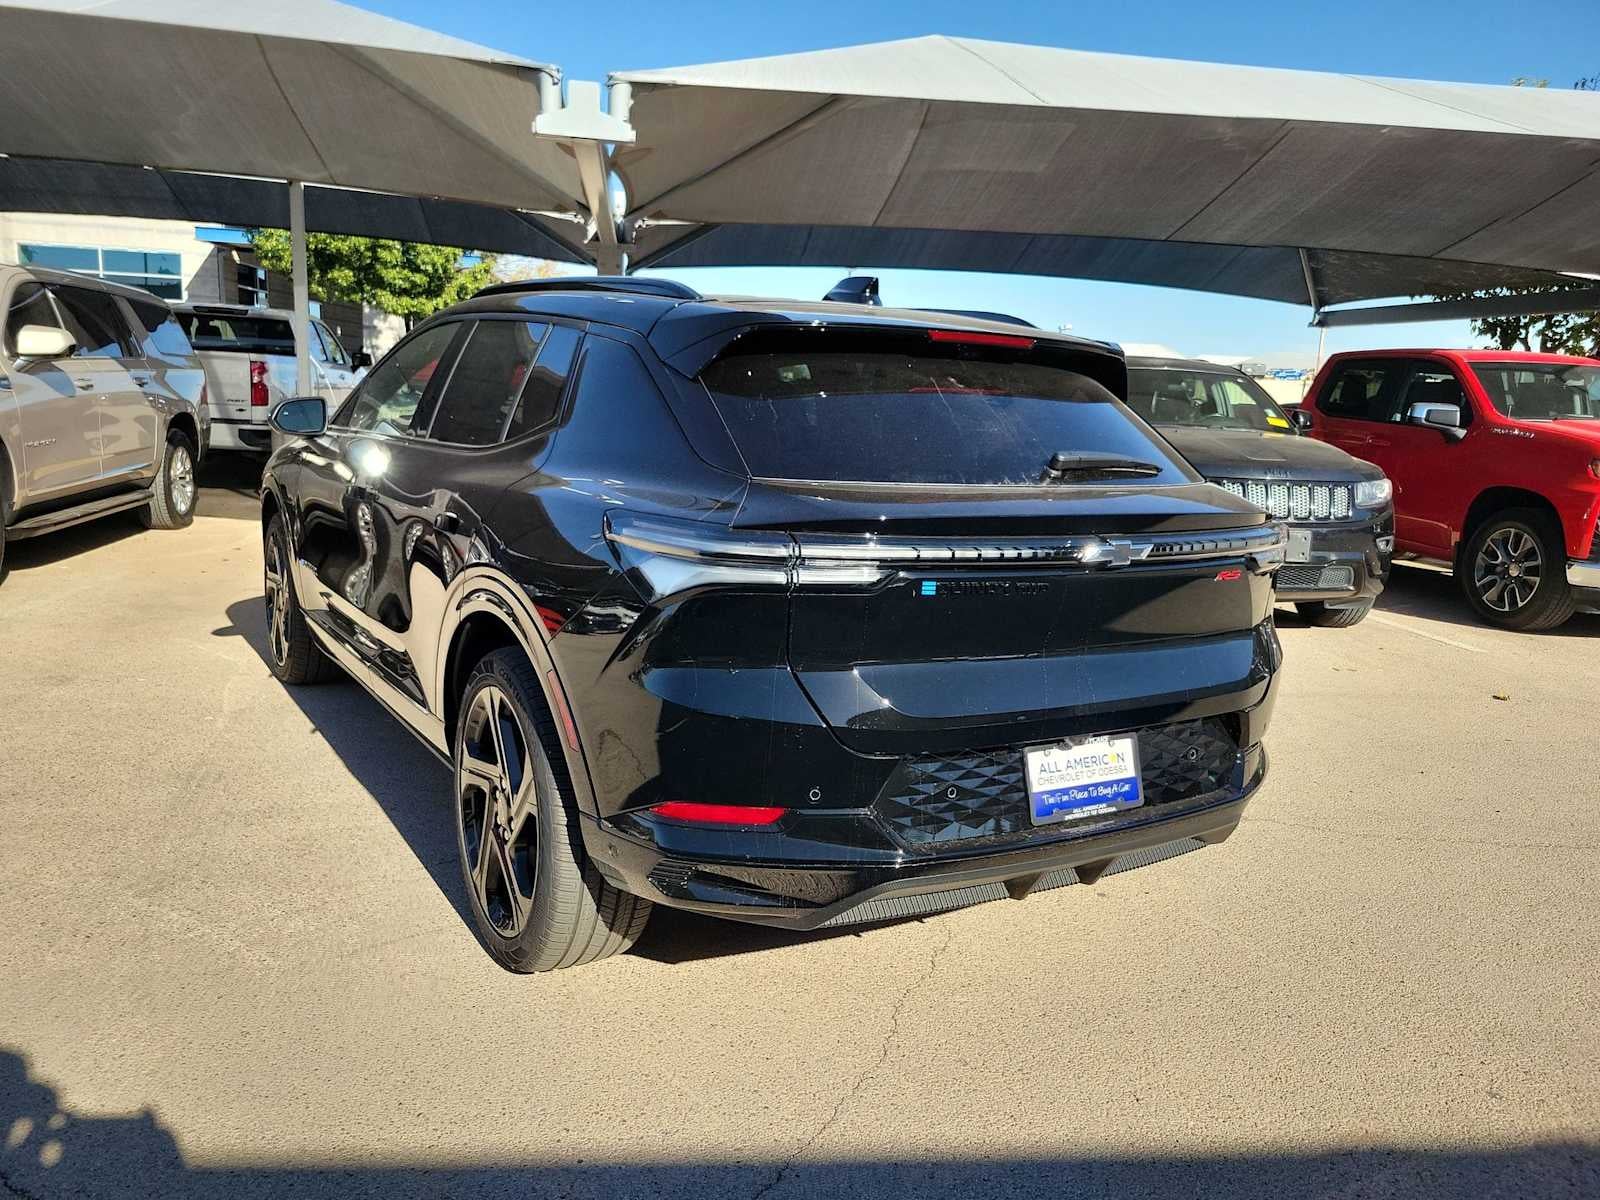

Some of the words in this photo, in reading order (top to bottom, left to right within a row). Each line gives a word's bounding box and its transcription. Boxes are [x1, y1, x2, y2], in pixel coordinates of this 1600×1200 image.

[1214, 569, 1241, 581] RS
[1039, 761, 1062, 774] ALL
[1066, 752, 1125, 770] AMERICN
[1037, 771, 1084, 786] CHEVROLET
